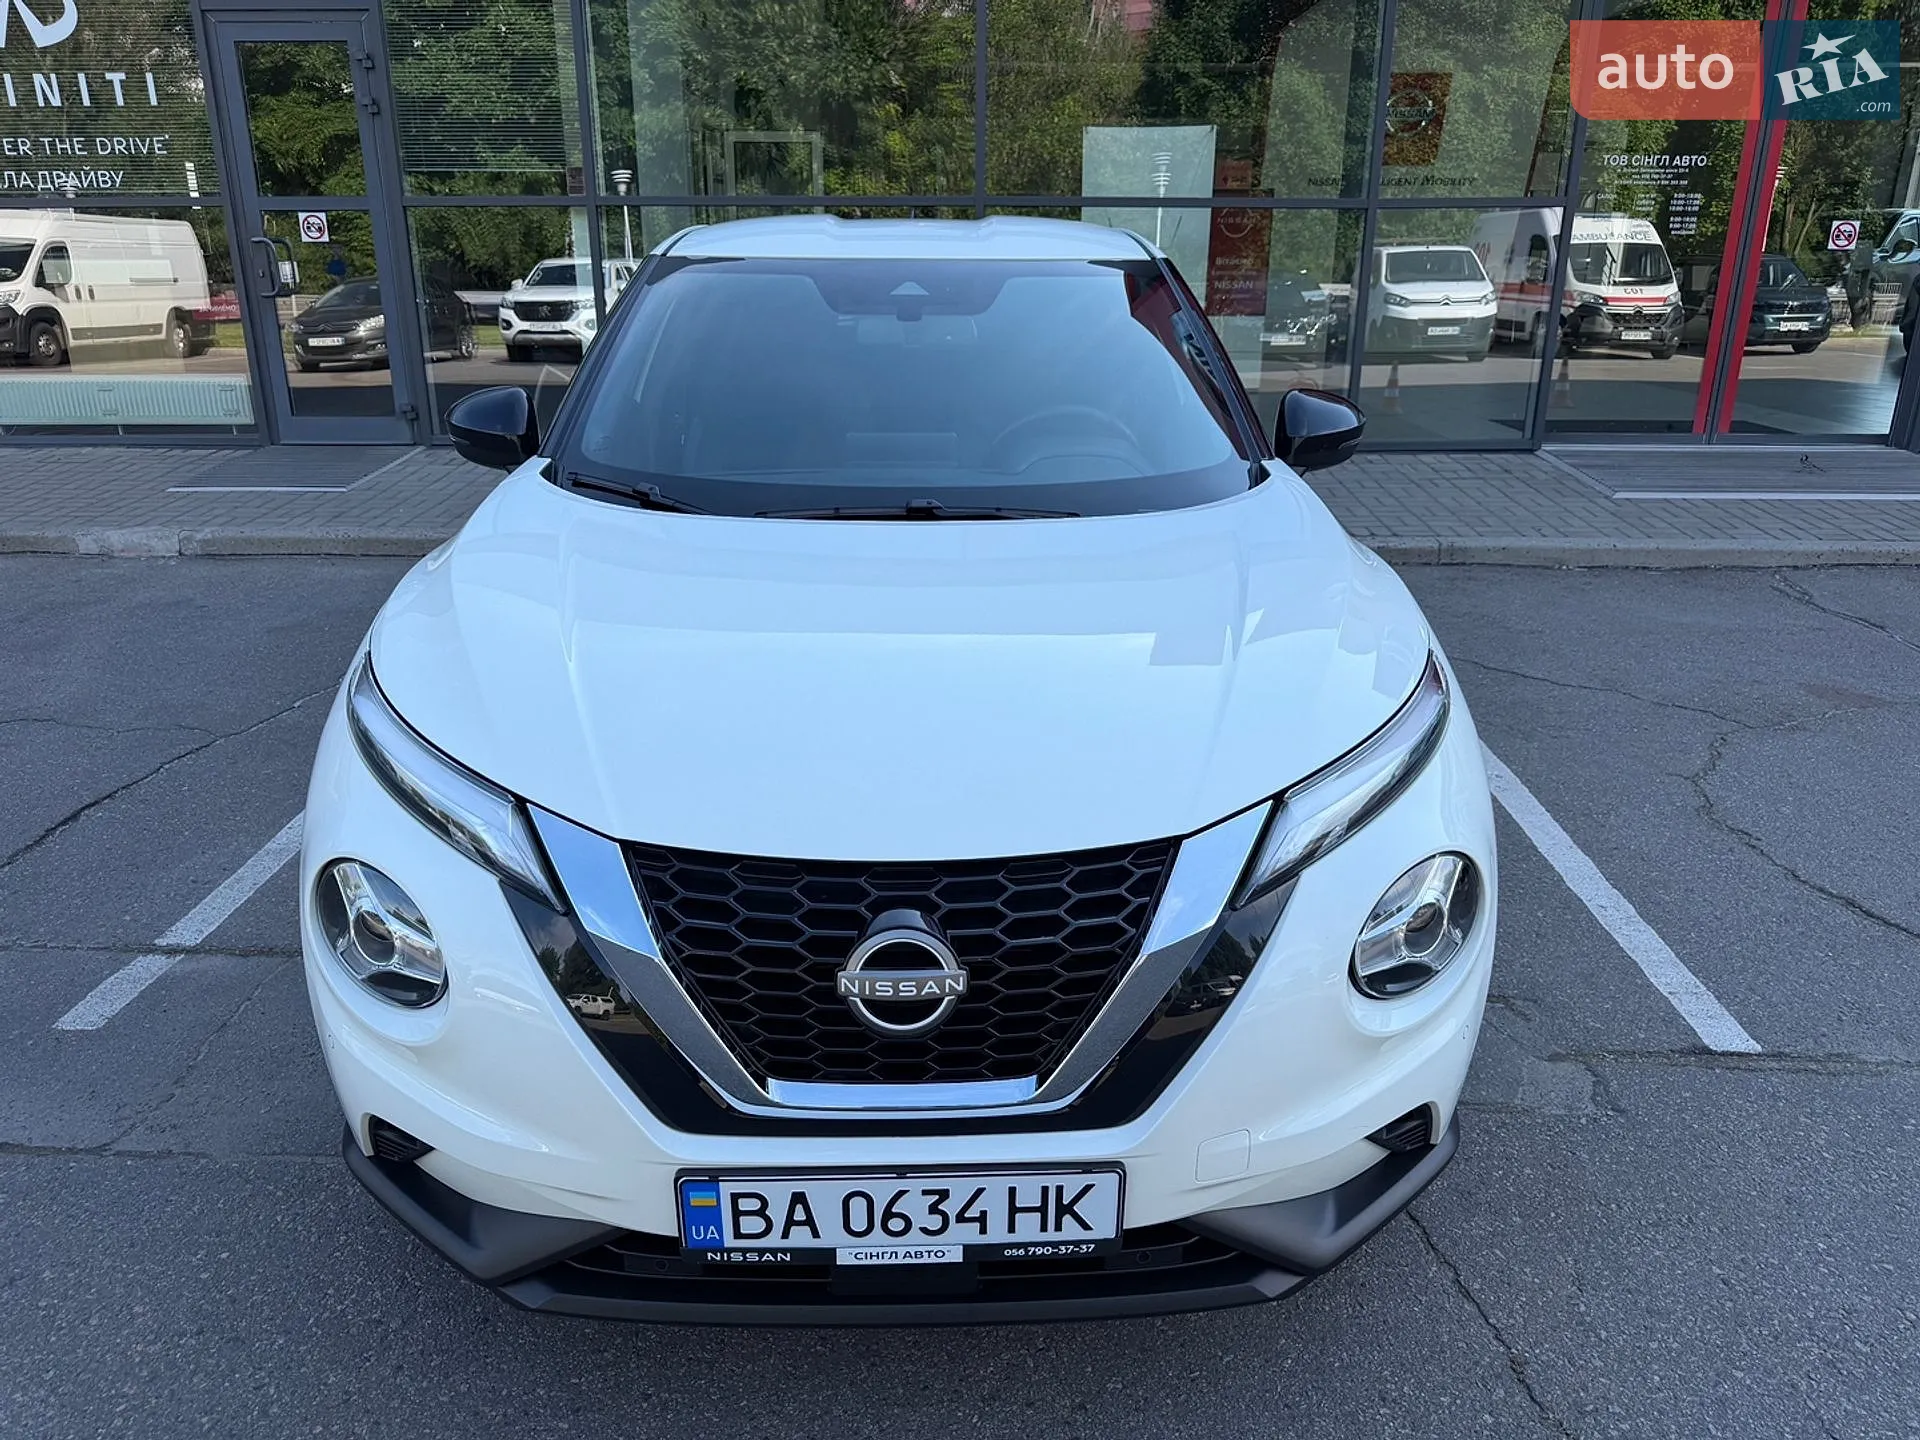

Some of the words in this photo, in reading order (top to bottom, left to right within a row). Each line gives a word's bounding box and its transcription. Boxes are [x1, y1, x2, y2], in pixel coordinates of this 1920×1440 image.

[40, 137, 88, 155] THE
[1602, 154, 1628, 166] ТОВ
[1631, 154, 1670, 166] СІНГЛ
[1672, 154, 1707, 166] АВТО
[0, 170, 34, 189] ЛА
[37, 165, 124, 192] ДРАЙВУ
[1214, 280, 1254, 289] NISSAN
[841, 976, 964, 996] NISSAN
[730, 1190, 822, 1240] BA
[841, 1186, 989, 1239] 0634
[1007, 1183, 1096, 1235] HK
[691, 1225, 720, 1240] UA
[707, 1252, 791, 1262] NISSAN
[1004, 1248, 1025, 1256] 056
[1027, 1243, 1096, 1256] 790-37-37
